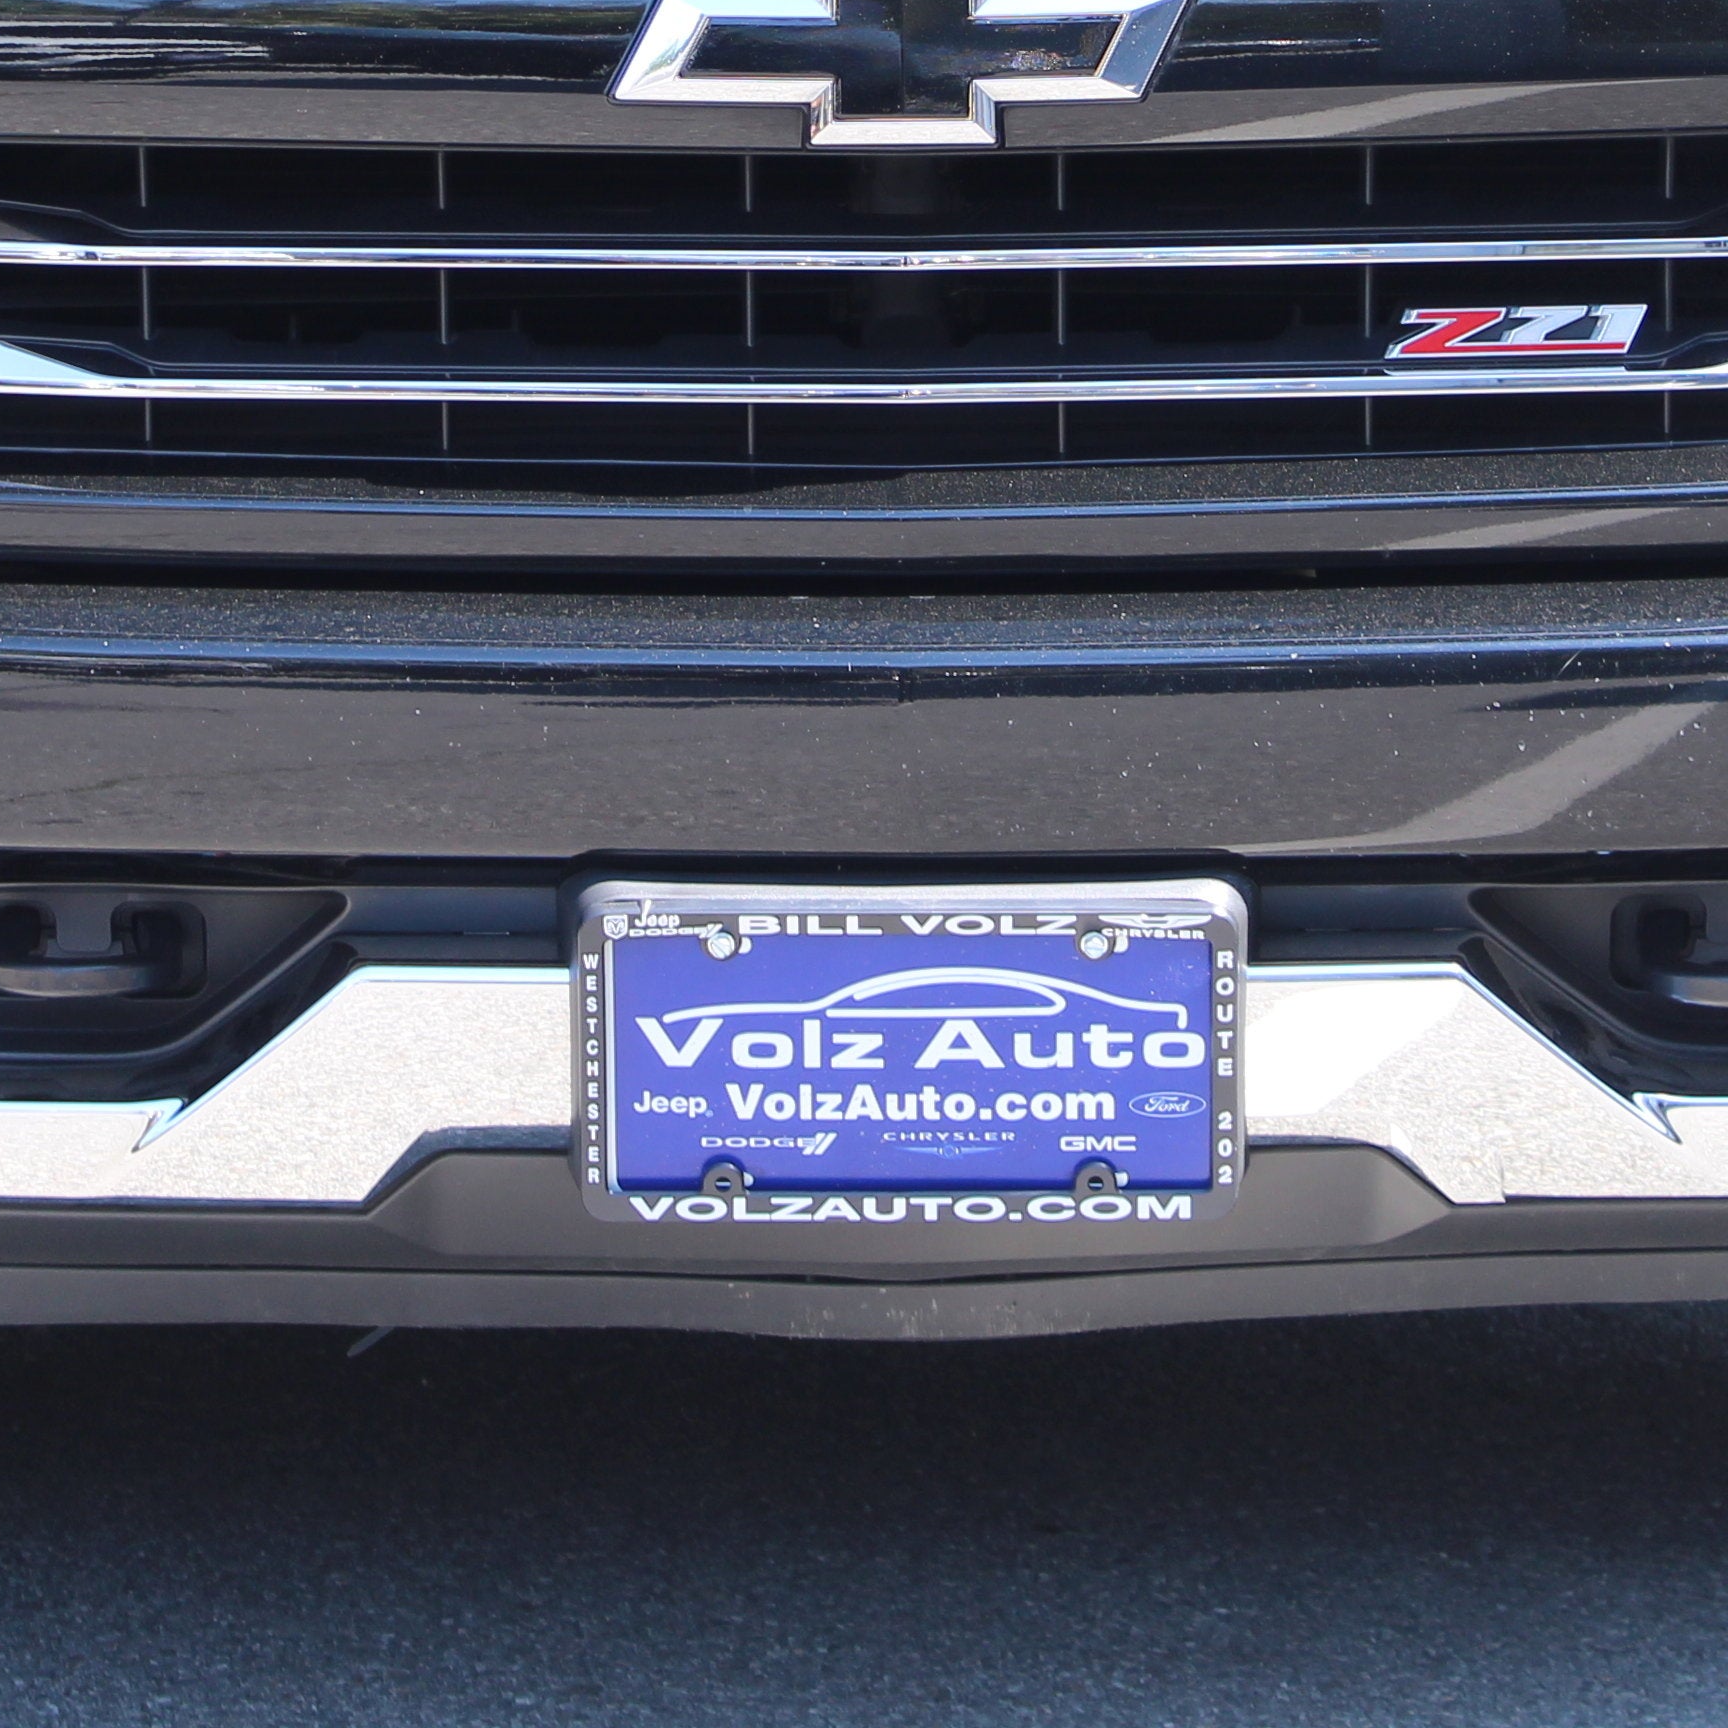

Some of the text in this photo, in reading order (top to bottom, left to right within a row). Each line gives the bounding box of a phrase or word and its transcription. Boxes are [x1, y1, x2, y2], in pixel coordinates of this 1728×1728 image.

[1383, 303, 1648, 359] Z71
[634, 910, 680, 928] Jeep
[738, 915, 1078, 937] BILL VOLZ
[1101, 928, 1205, 940] CHRYSLER
[634, 1017, 1206, 1070] Volz Auto
[583, 954, 600, 1184] WESTCHESTER
[1216, 950, 1234, 1184] ROUTE 202
[633, 1090, 709, 1118] Jeep
[725, 1083, 1115, 1121] VolzAuto.com
[1143, 1095, 1191, 1114] Ford
[700, 1134, 822, 1151] DODGE
[883, 1131, 1016, 1143] CHRYSLER
[1059, 1135, 1138, 1152] GMC
[629, 1195, 1193, 1223] VOLZAUTO.COM
